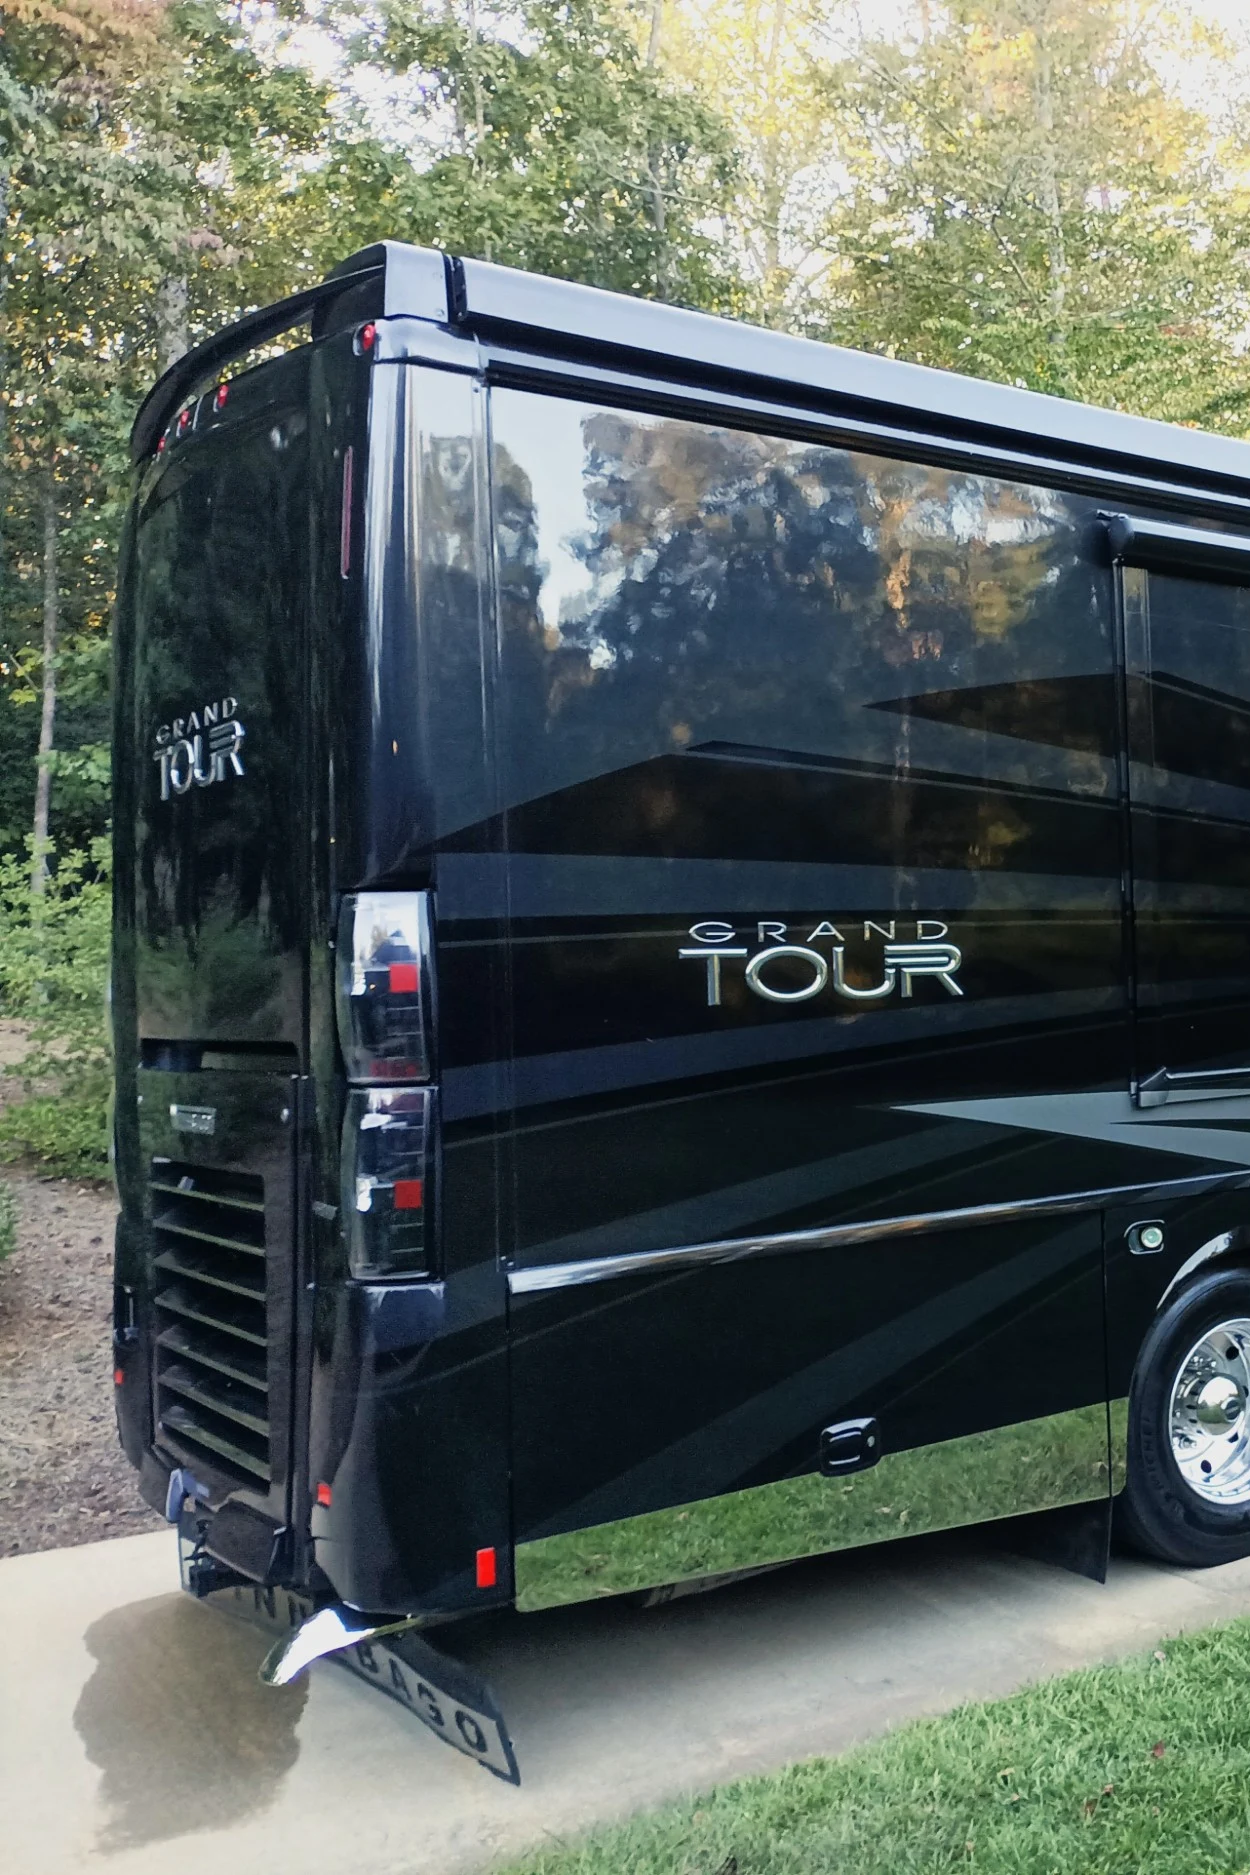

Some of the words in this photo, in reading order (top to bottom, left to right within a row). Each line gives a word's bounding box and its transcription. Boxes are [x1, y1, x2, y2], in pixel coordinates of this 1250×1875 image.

[157, 697, 238, 744] GRAND
[153, 721, 245, 801] TOUR
[689, 921, 949, 943] GRAND
[679, 945, 964, 1006] TOUR
